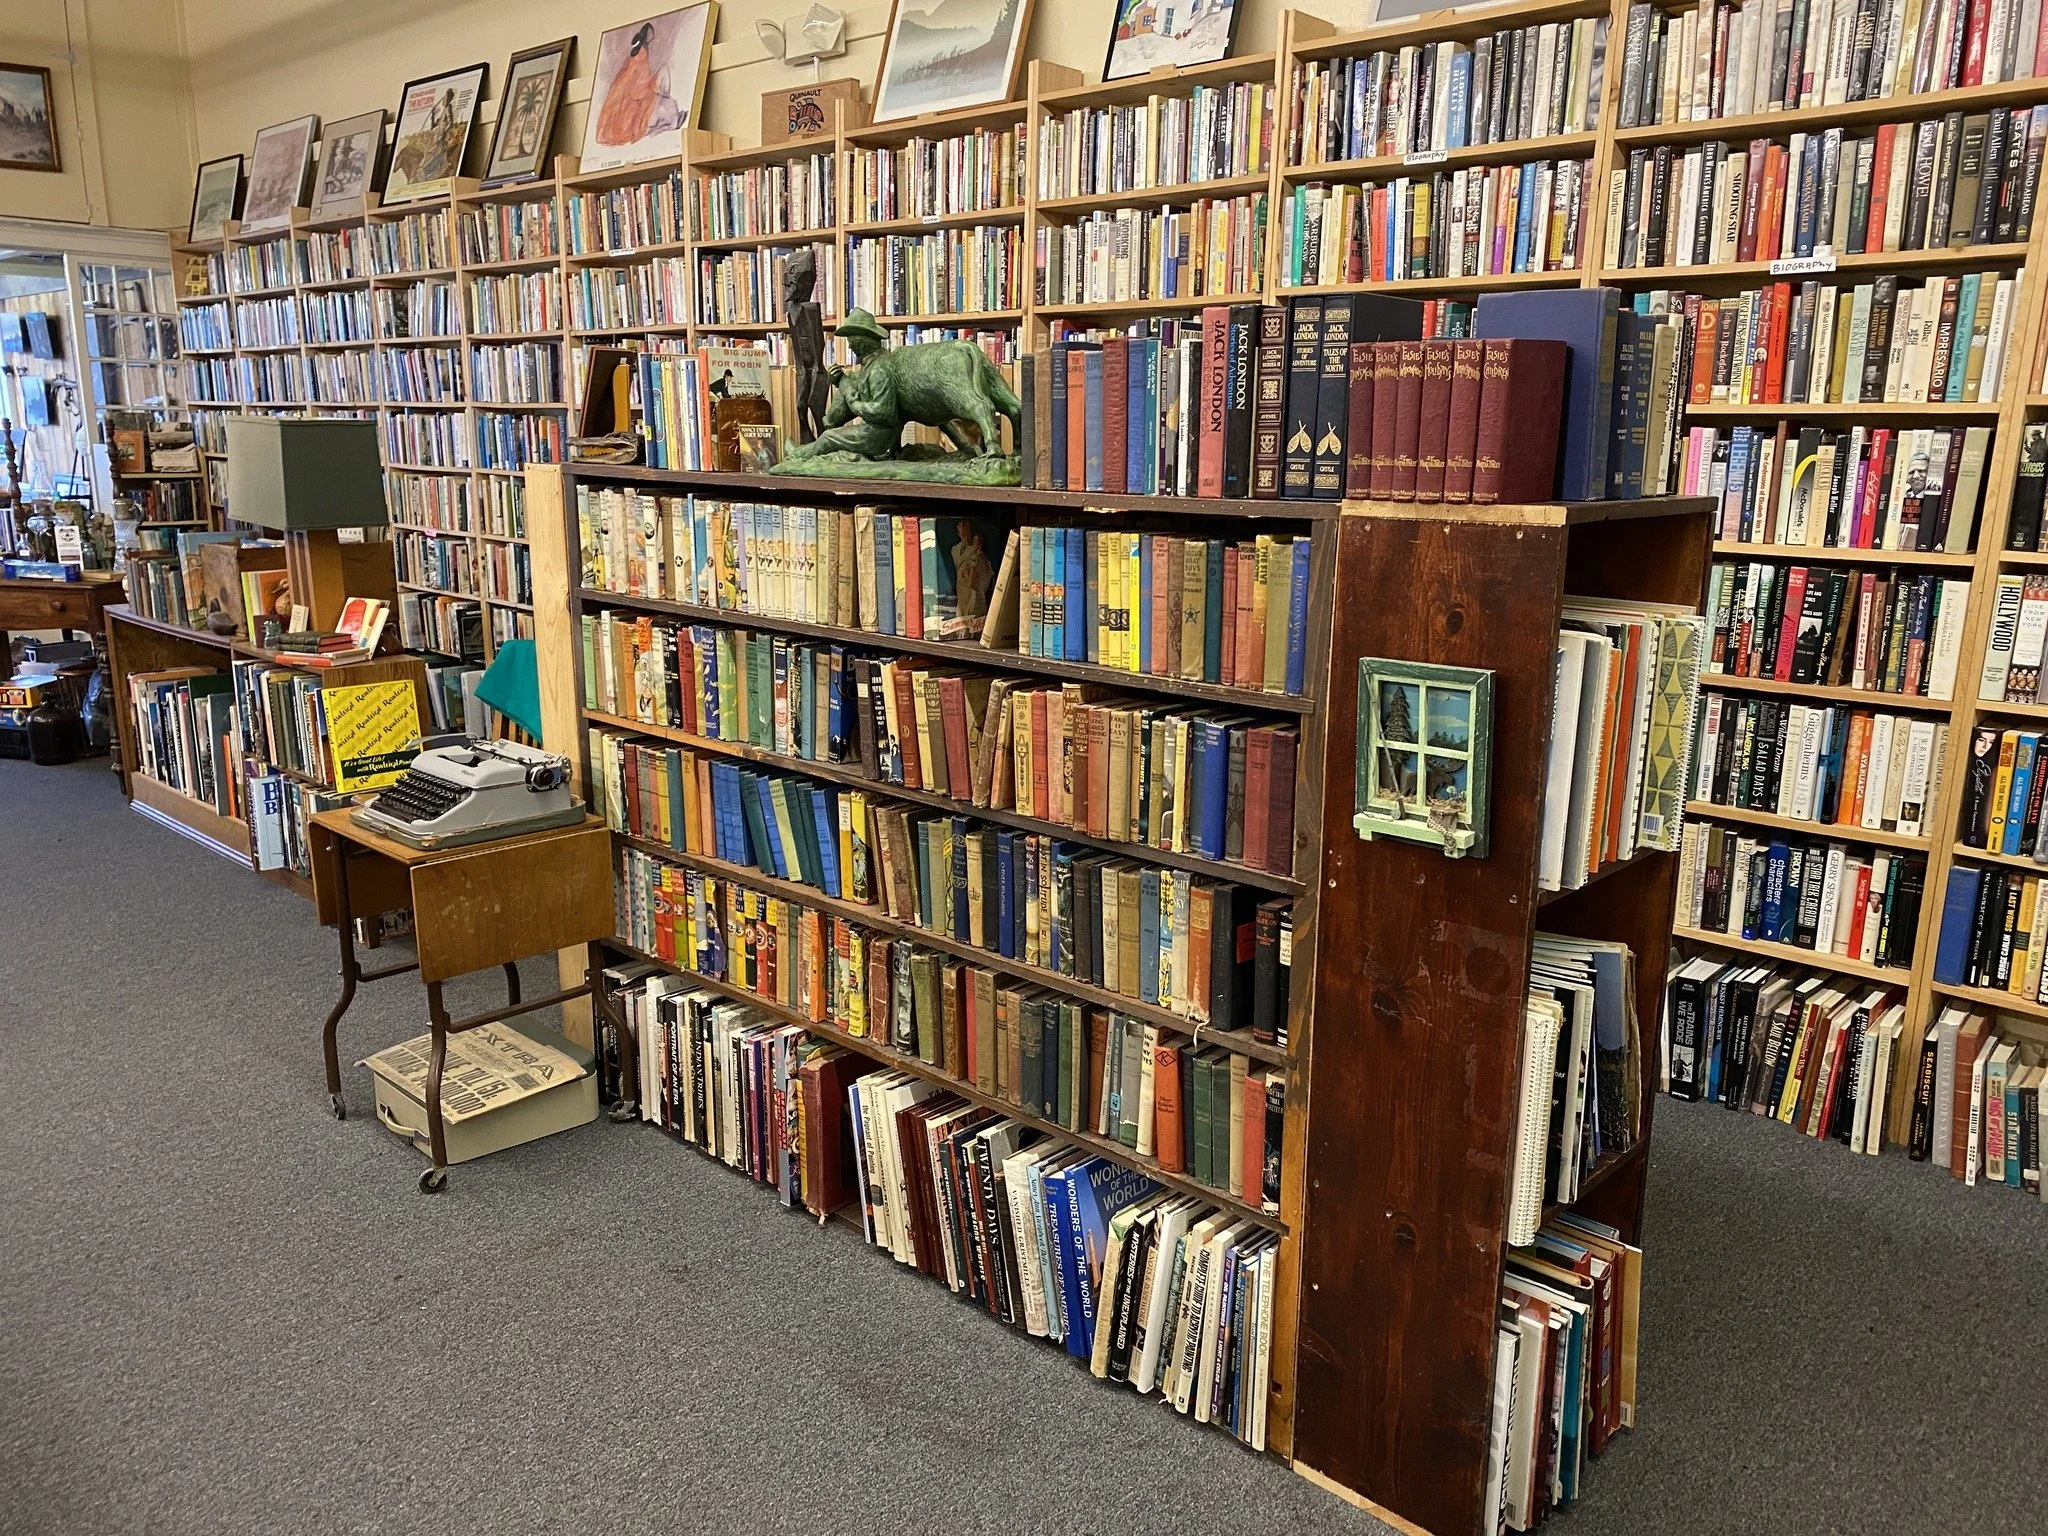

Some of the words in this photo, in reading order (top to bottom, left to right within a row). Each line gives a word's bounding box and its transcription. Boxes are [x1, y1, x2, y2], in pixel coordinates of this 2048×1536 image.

[789, 89, 822, 102] QUINAULT
[1451, 69, 1460, 112] HUXLEY
[1457, 69, 1466, 111] ALDOUS
[1386, 105, 1398, 143] SQUEAKY
[1949, 118, 1957, 131] Life
[1994, 112, 2005, 137] Paul
[1990, 137, 2001, 160] Allen
[2009, 121, 2023, 168] GATES
[2030, 147, 2038, 163] THE
[1555, 164, 1569, 200] Wink
[1657, 154, 1666, 186] DANIEL
[2026, 164, 2036, 187] ROAD
[1728, 173, 1742, 221] SHOOTING
[1750, 183, 1759, 209] George
[1803, 165, 1814, 204] NORMAN
[2022, 188, 2031, 215] AHEAD
[1121, 218, 1130, 259] WORKING
[1726, 221, 1737, 243] STAR
[1700, 301, 1719, 312] JOHN
[1298, 324, 1314, 332] JACK
[1328, 324, 1344, 332] JACK
[1701, 312, 1717, 330] D
[1723, 311, 1732, 331] John
[1921, 321, 1933, 342] Rilke
[1213, 320, 1226, 362] JACK
[1230, 323, 1238, 353] Stories
[1237, 323, 1249, 354] JACK
[1293, 332, 1319, 340] LONDON
[1324, 333, 1349, 341] LONDON
[712, 360, 731, 368] FOR
[733, 360, 761, 368] ROBIN
[742, 349, 768, 358] JUMP
[1229, 354, 1237, 365] of
[1323, 348, 1340, 356] TALES
[1353, 348, 1374, 363] ELSIE
[1486, 346, 1509, 363] ELSIE'S
[1717, 340, 1729, 383] Rockefeller
[1932, 322, 1952, 387] IMPRESARIO
[1325, 364, 1344, 372] NORTH
[1484, 363, 1510, 381] CHILDREN
[1228, 365, 1237, 410] Adventure
[1236, 356, 1248, 410] LONDON
[1210, 366, 1224, 432] LONDON
[1676, 398, 1684, 420] BOB
[1673, 426, 1682, 463] DYLAN
[1832, 474, 1841, 496] Joseph
[1797, 487, 1808, 527] McDonald's
[1829, 496, 1838, 514] Heller
[1260, 546, 1268, 559] THE
[1260, 560, 1268, 585] FIVE
[1291, 575, 1302, 653] DRAGONWYCK
[1737, 590, 1746, 620] JAMES
[1827, 594, 1837, 626] HAMILTON
[1992, 586, 2020, 652] HOLLYWOOD
[1734, 623, 1742, 649] DEAN
[1777, 719, 1788, 745] Wildest
[1755, 742, 1769, 772] SALAD
[1801, 712, 1820, 781] Guggenheims
[368, 759, 400, 771] Rawleigh
[1773, 746, 1784, 774] Dream
[1752, 774, 1765, 797] DAYS
[1790, 851, 1802, 888] BROWN
[1828, 852, 1840, 878] GERRY
[1825, 879, 1837, 915] SPENCE
[2008, 892, 2017, 909] LAST
[2004, 910, 2015, 932] WORDS
[1678, 1000, 1687, 1017] WE
[670, 1020, 678, 1062] PORTRAIT
[1675, 1018, 1685, 1044] RODE
[1685, 1012, 1696, 1046] TRAINS
[1772, 1020, 1785, 1039] SAUL
[1799, 1026, 1813, 1057] Remember
[1764, 1039, 1781, 1067] BELLOW
[672, 1063, 678, 1075] OF
[1796, 1058, 1807, 1076] When
[1921, 1051, 1934, 1106] SEABISCUIT
[672, 1075, 679, 1087] AN
[863, 1117, 871, 1142] Pageant
[867, 1150, 876, 1174] Painting
[977, 1142, 994, 1203] TWENTY
[986, 1206, 999, 1245] DAYS
[1102, 1178, 1149, 1211] WORLD
[1110, 1179, 1123, 1190] OF
[1066, 1178, 1081, 1233] WONDERS
[1012, 1189, 1023, 1233] VANISHED
[1018, 1235, 1031, 1290] GRISTMILLS
[1048, 1202, 1062, 1270] TREASURES
[1074, 1236, 1082, 1250] OF
[1076, 1254, 1087, 1277] THE
[1127, 1230, 1140, 1277] MYSTERIES
[1145, 1250, 1156, 1275] KNOTS
[1173, 1253, 1181, 1274] HOME
[1197, 1250, 1210, 1283] COMPLETE
[1058, 1271, 1066, 1284] OF
[1263, 1260, 1272, 1279] THE
[1080, 1280, 1092, 1319] WORLD
[1138, 1282, 1150, 1324] ROPEWORK
[1166, 1290, 1176, 1321] JAPANESE
[1194, 1283, 1205, 1305] GUIDE
[1060, 1284, 1071, 1337] AMERICA
[1116, 1292, 1131, 1350] UNEXPLAINED
[1191, 1304, 1200, 1315] TO
[1220, 1293, 1228, 1326] PAINTINGS
[1260, 1281, 1271, 1335] TELEPHONE
[1162, 1322, 1171, 1347] DESIGN
[1187, 1313, 1199, 1341] ACRYLIC
[1182, 1341, 1194, 1373] PAINTING
[1258, 1337, 1268, 1357] BOOK
